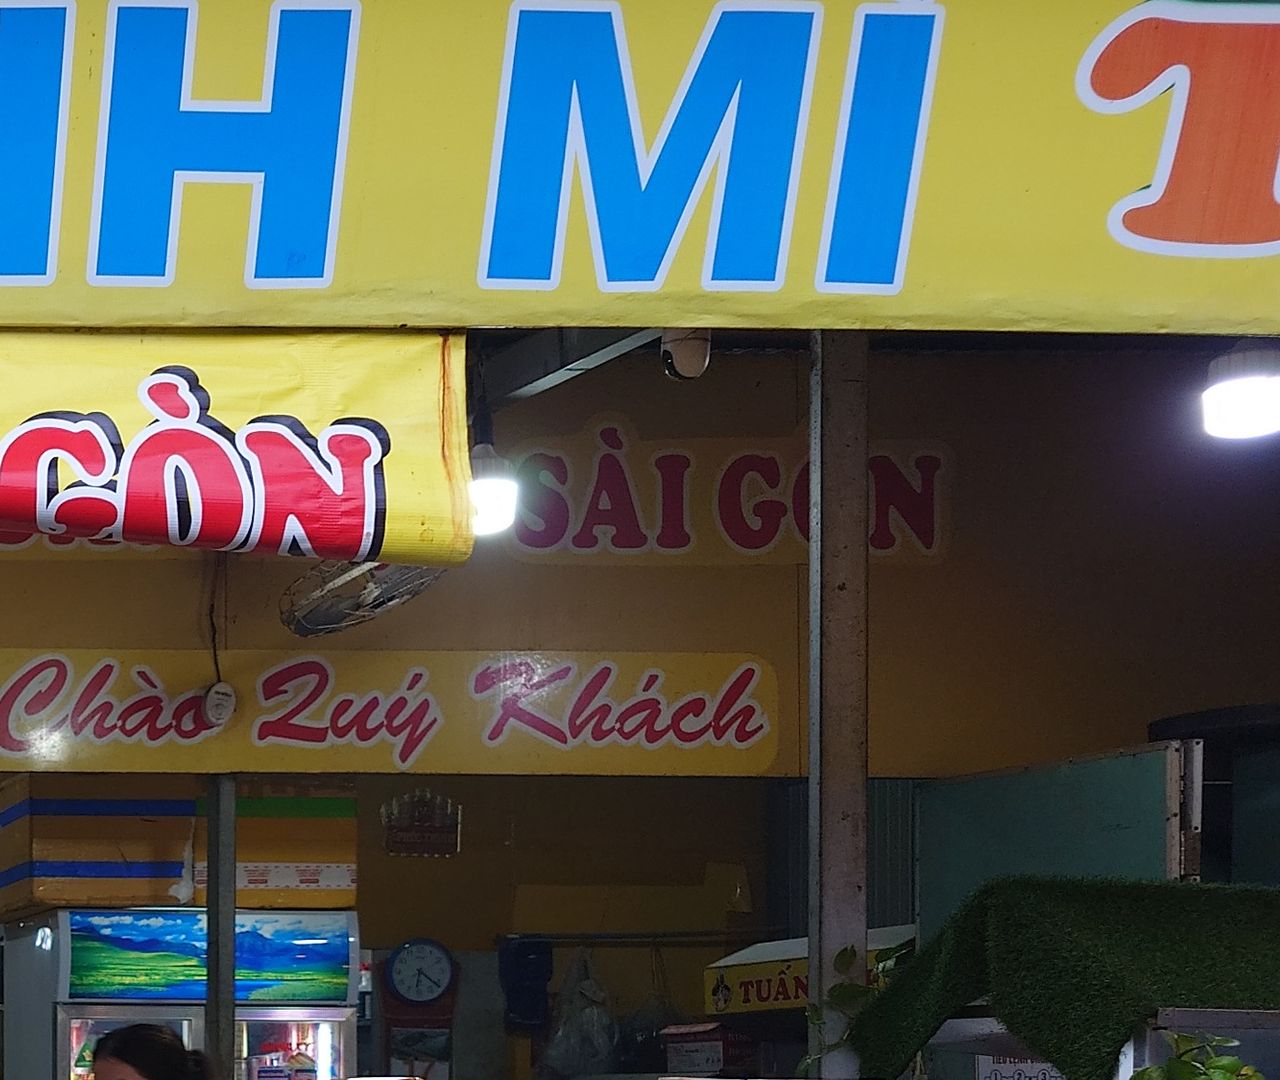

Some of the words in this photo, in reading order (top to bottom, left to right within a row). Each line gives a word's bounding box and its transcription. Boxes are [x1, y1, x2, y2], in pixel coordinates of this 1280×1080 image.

[515, 426, 692, 549] SÀI
[717, 453, 941, 550] GN
[255, 658, 438, 766] Quý
[474, 659, 767, 745] Khách
